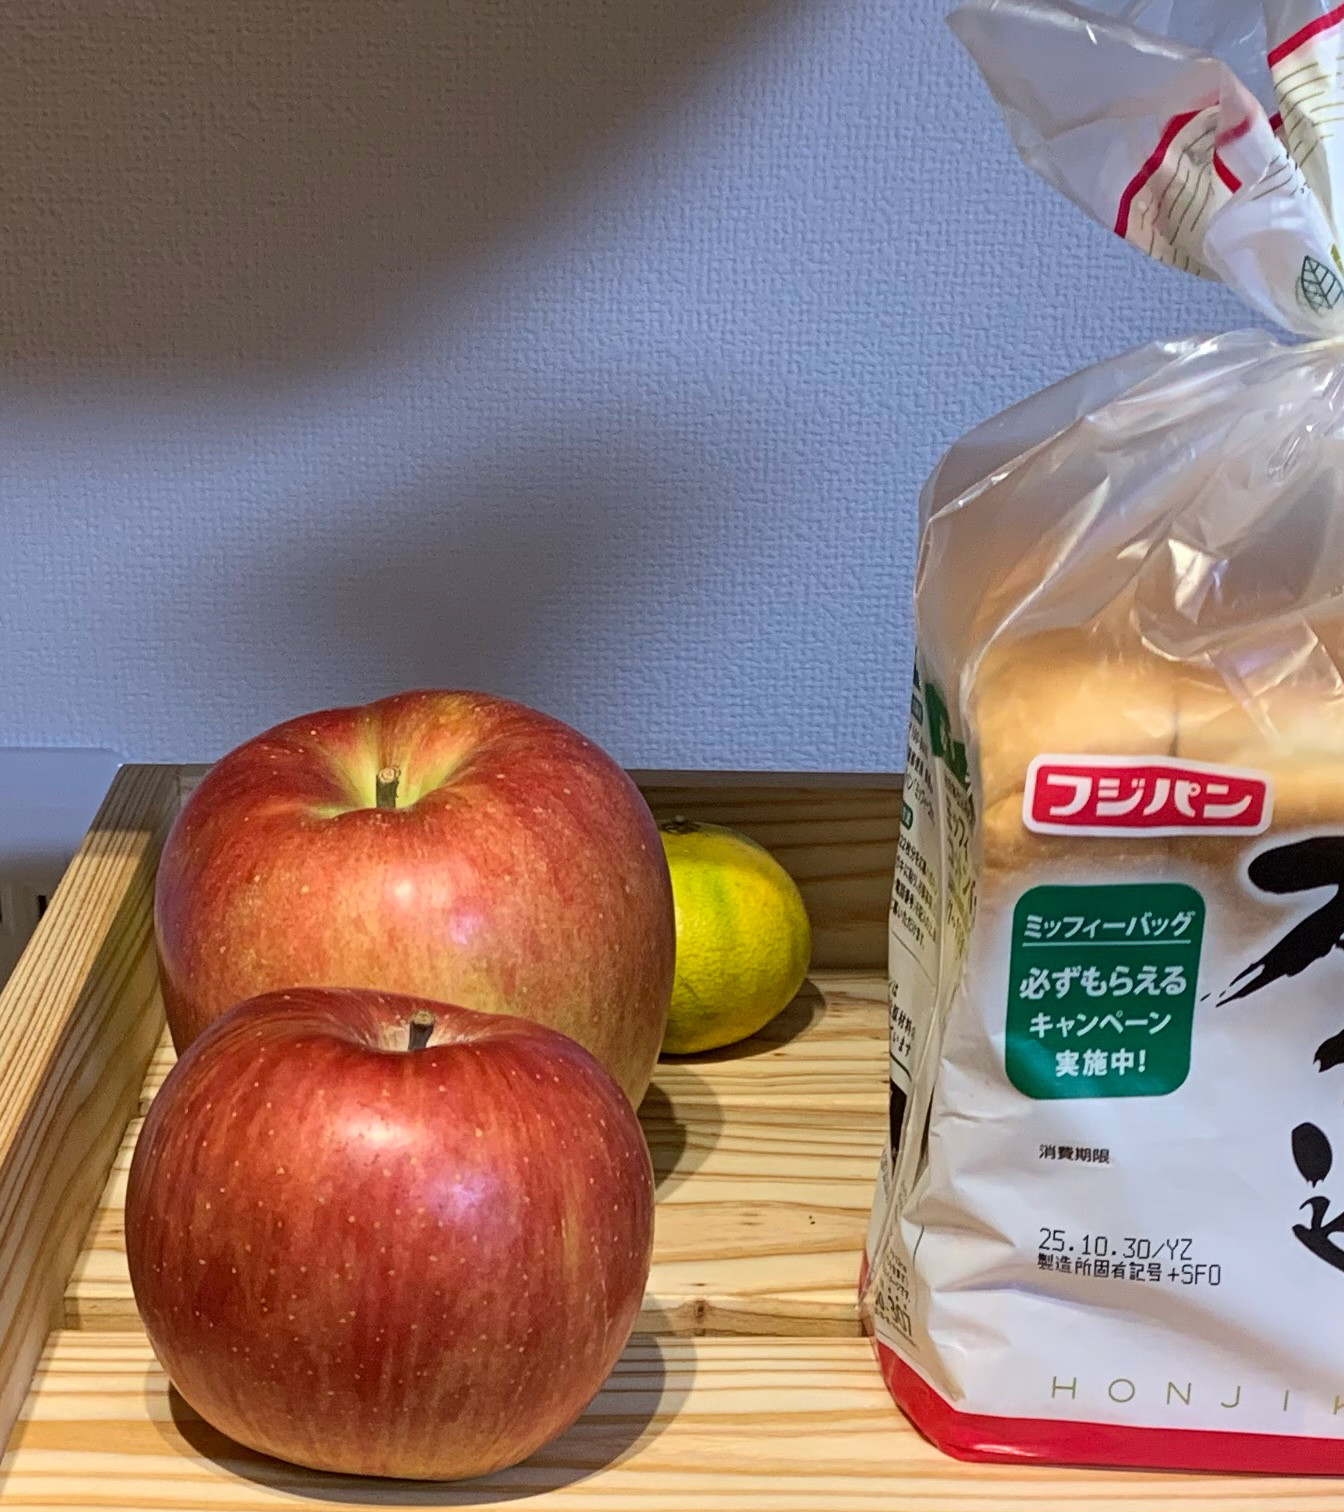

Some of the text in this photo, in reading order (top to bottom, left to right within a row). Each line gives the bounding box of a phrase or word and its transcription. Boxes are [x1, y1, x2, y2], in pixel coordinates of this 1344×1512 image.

[1047, 774, 1253, 819] フジパン
[1024, 911, 1196, 938] ミッフィーバッグ
[1019, 965, 1187, 999] 必ずもらえる
[1029, 1010, 1172, 1038] キャンペーン
[1055, 1048, 1146, 1077] 実施中!
[1039, 1144, 1110, 1164] 消費期限
[1038, 1227, 1193, 1261] 25.10.30/YZ
